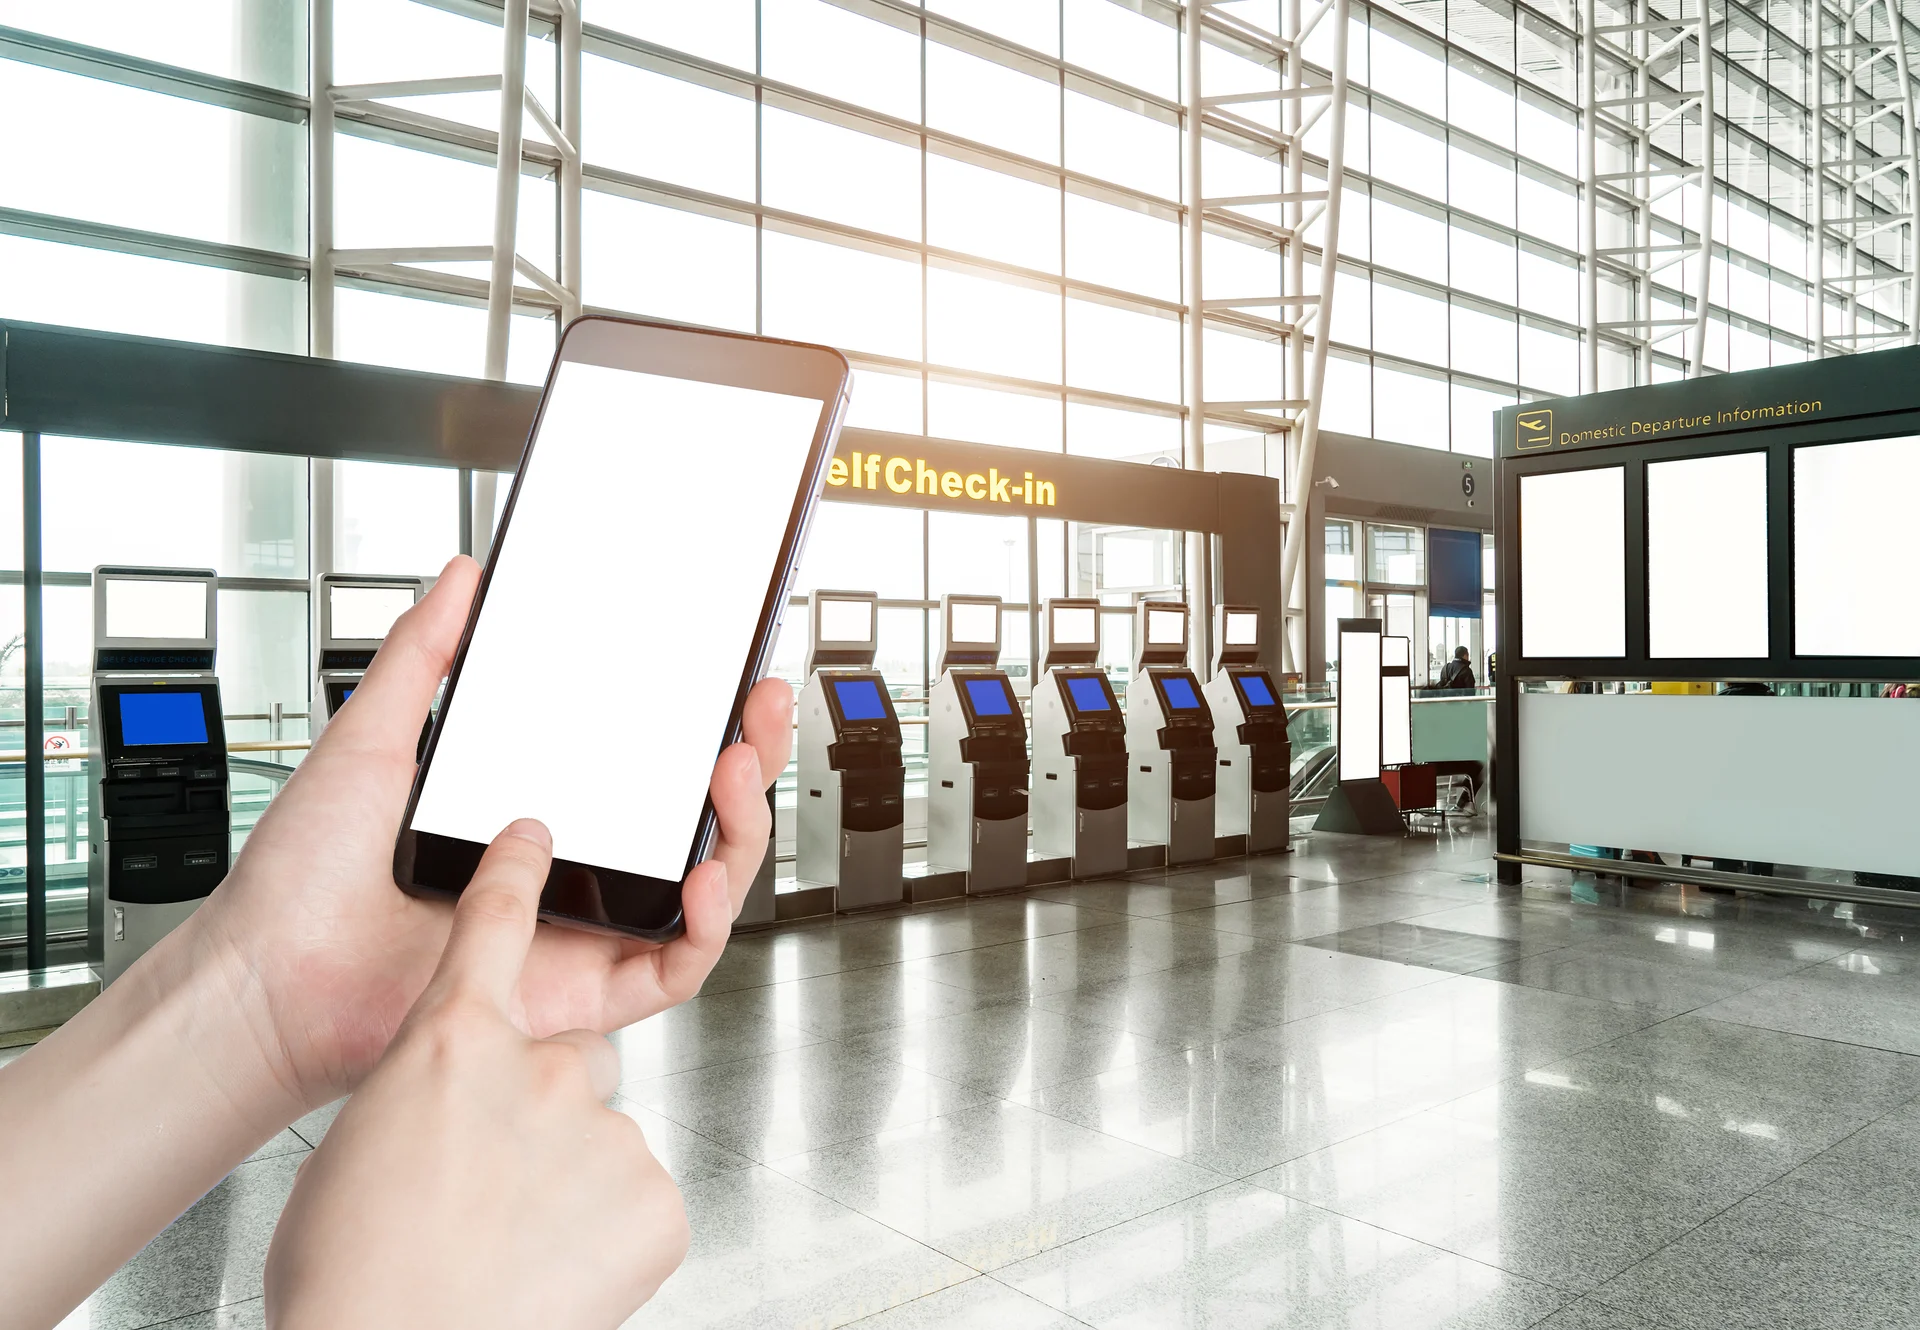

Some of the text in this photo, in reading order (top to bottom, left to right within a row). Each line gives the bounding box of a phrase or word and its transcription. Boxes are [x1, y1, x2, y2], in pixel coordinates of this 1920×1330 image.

[1560, 400, 1822, 445] Domestic Departure Information
[825, 451, 1056, 506] elfCheck-in
[1465, 477, 1472, 493] 5
